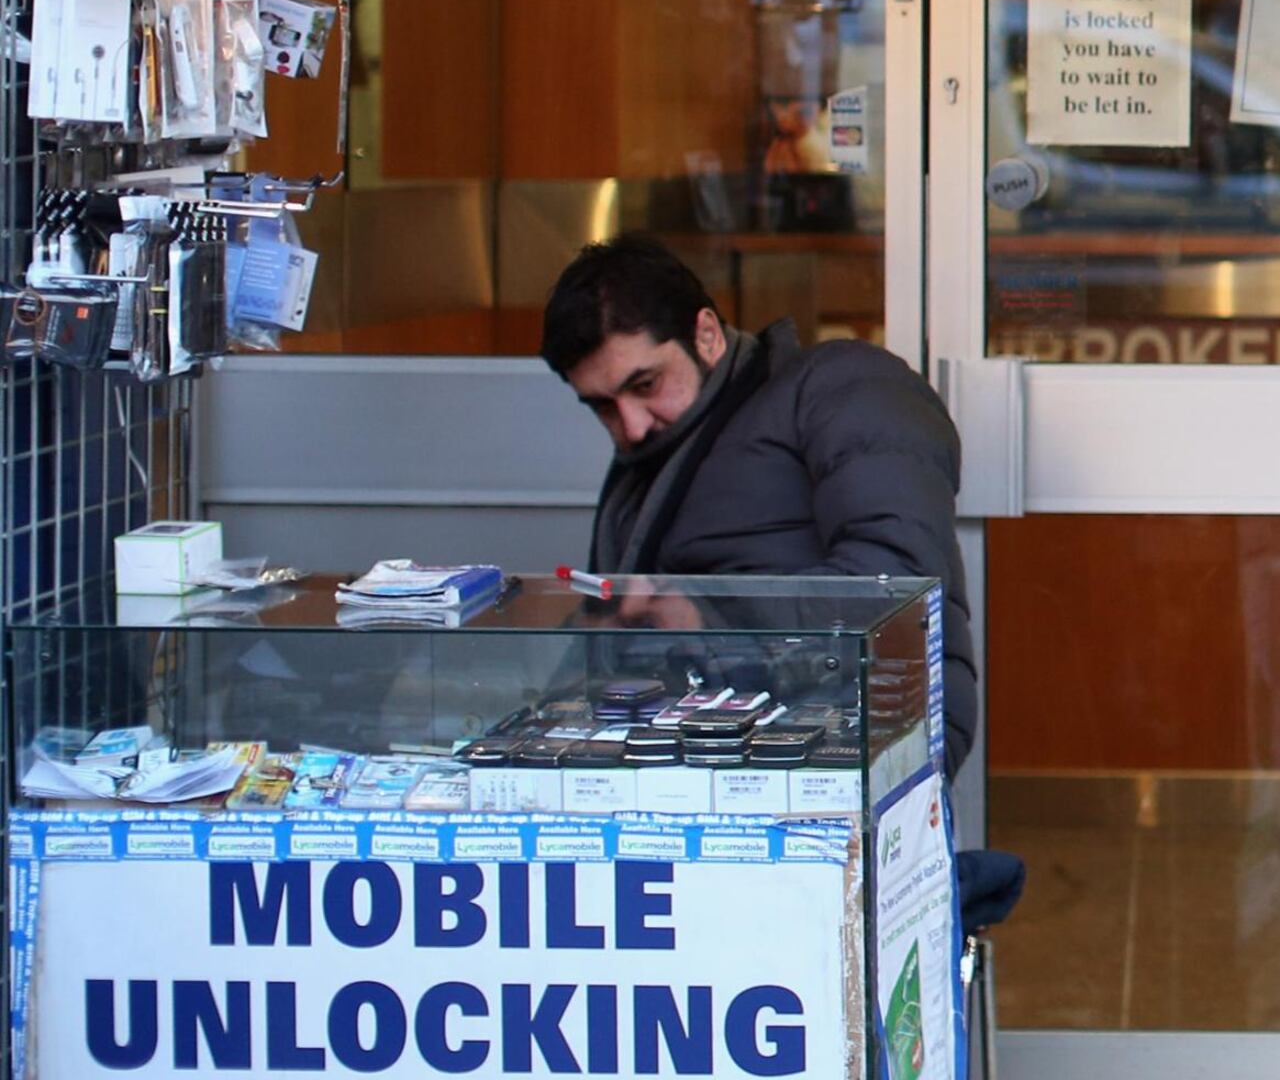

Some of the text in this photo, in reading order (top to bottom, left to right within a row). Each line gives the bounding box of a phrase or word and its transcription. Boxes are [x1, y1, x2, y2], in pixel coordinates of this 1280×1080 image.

[1065, 10, 1154, 29] is locked
[1063, 40, 1155, 61] you have
[1060, 69, 1158, 85] to wait to
[1064, 96, 1152, 114] be let in.
[993, 178, 1028, 194] PUSH
[48, 841, 109, 851] Lycamobile
[130, 839, 190, 850] Lycamobile
[211, 841, 272, 852] Lycamobile
[293, 840, 354, 851] Lycamobile
[374, 840, 435, 852] Lycamobile
[457, 842, 518, 853] Lycamobile
[539, 841, 602, 853] Lycamobile
[621, 839, 683, 852] Lycamobile
[704, 841, 766, 853] Lycamobile
[209, 861, 675, 950] MOBILE
[85, 979, 806, 1078] UNLOCKING
